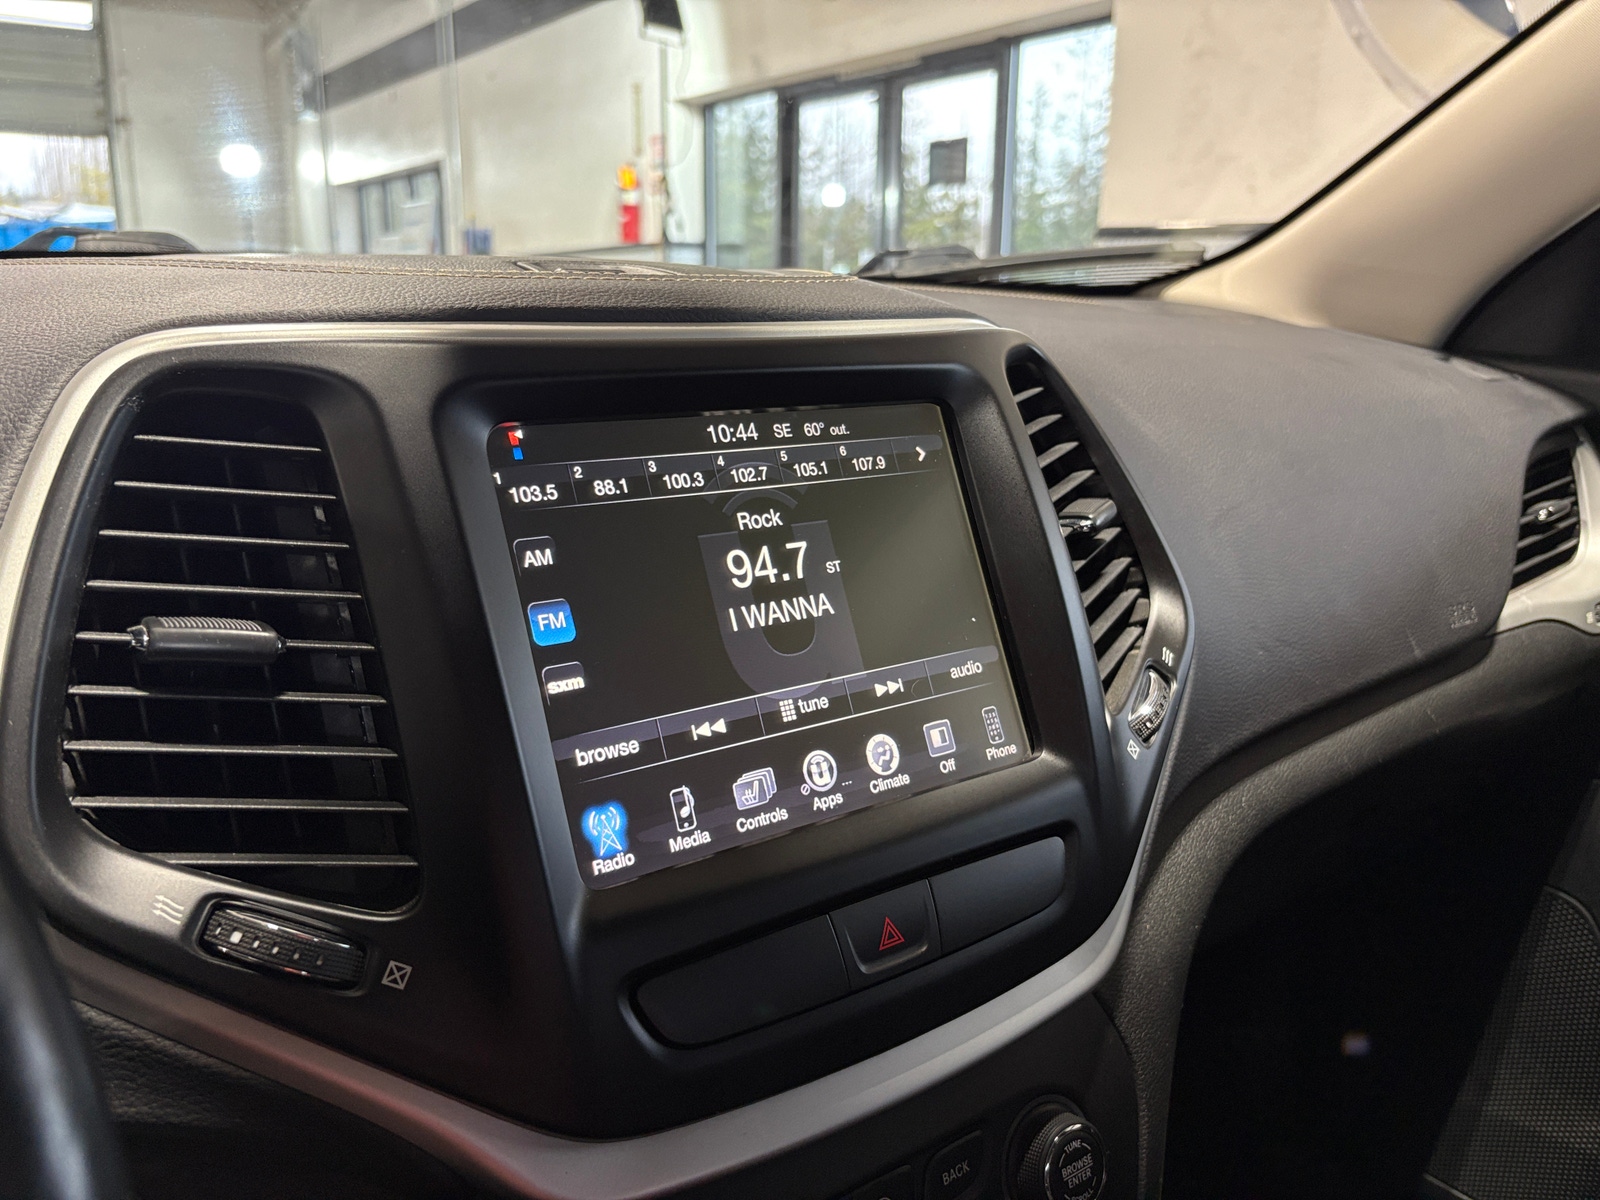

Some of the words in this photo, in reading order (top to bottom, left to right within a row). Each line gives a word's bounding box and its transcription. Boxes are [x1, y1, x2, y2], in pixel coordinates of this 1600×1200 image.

[706, 422, 759, 444] 10:44
[772, 423, 793, 438] SE
[829, 423, 850, 436] out.
[717, 455, 725, 467] 4
[780, 450, 788, 462] 5
[839, 445, 847, 457] 6
[573, 466, 584, 479] 2
[647, 460, 657, 473] 3
[793, 461, 829, 478] 105.1
[851, 455, 887, 472] 107.9
[493, 472, 502, 485] 1
[662, 471, 705, 490] 100.3
[730, 466, 768, 484] 102.7
[508, 483, 559, 504] 103.5
[593, 477, 629, 496] 88.1
[736, 508, 784, 531] Rock
[523, 548, 554, 568] AM
[726, 540, 808, 589] 94.7
[825, 560, 842, 574] ST
[537, 611, 567, 632] FM
[728, 607, 739, 632] I
[741, 592, 836, 629] WANNA
[949, 660, 984, 680] audio
[797, 696, 830, 714] tune
[574, 739, 641, 767] browse
[985, 743, 1018, 761] Phone
[939, 757, 957, 774] Off
[869, 773, 911, 794] Climate
[813, 792, 844, 812] Apps
[736, 806, 789, 833] Controls
[668, 828, 712, 853] Media
[591, 851, 636, 876] Radio
[1064, 1139, 1082, 1154] TUNE
[942, 1159, 971, 1186] BACK
[1061, 1152, 1093, 1178] BROWSE
[1067, 1167, 1092, 1189] ENTER
